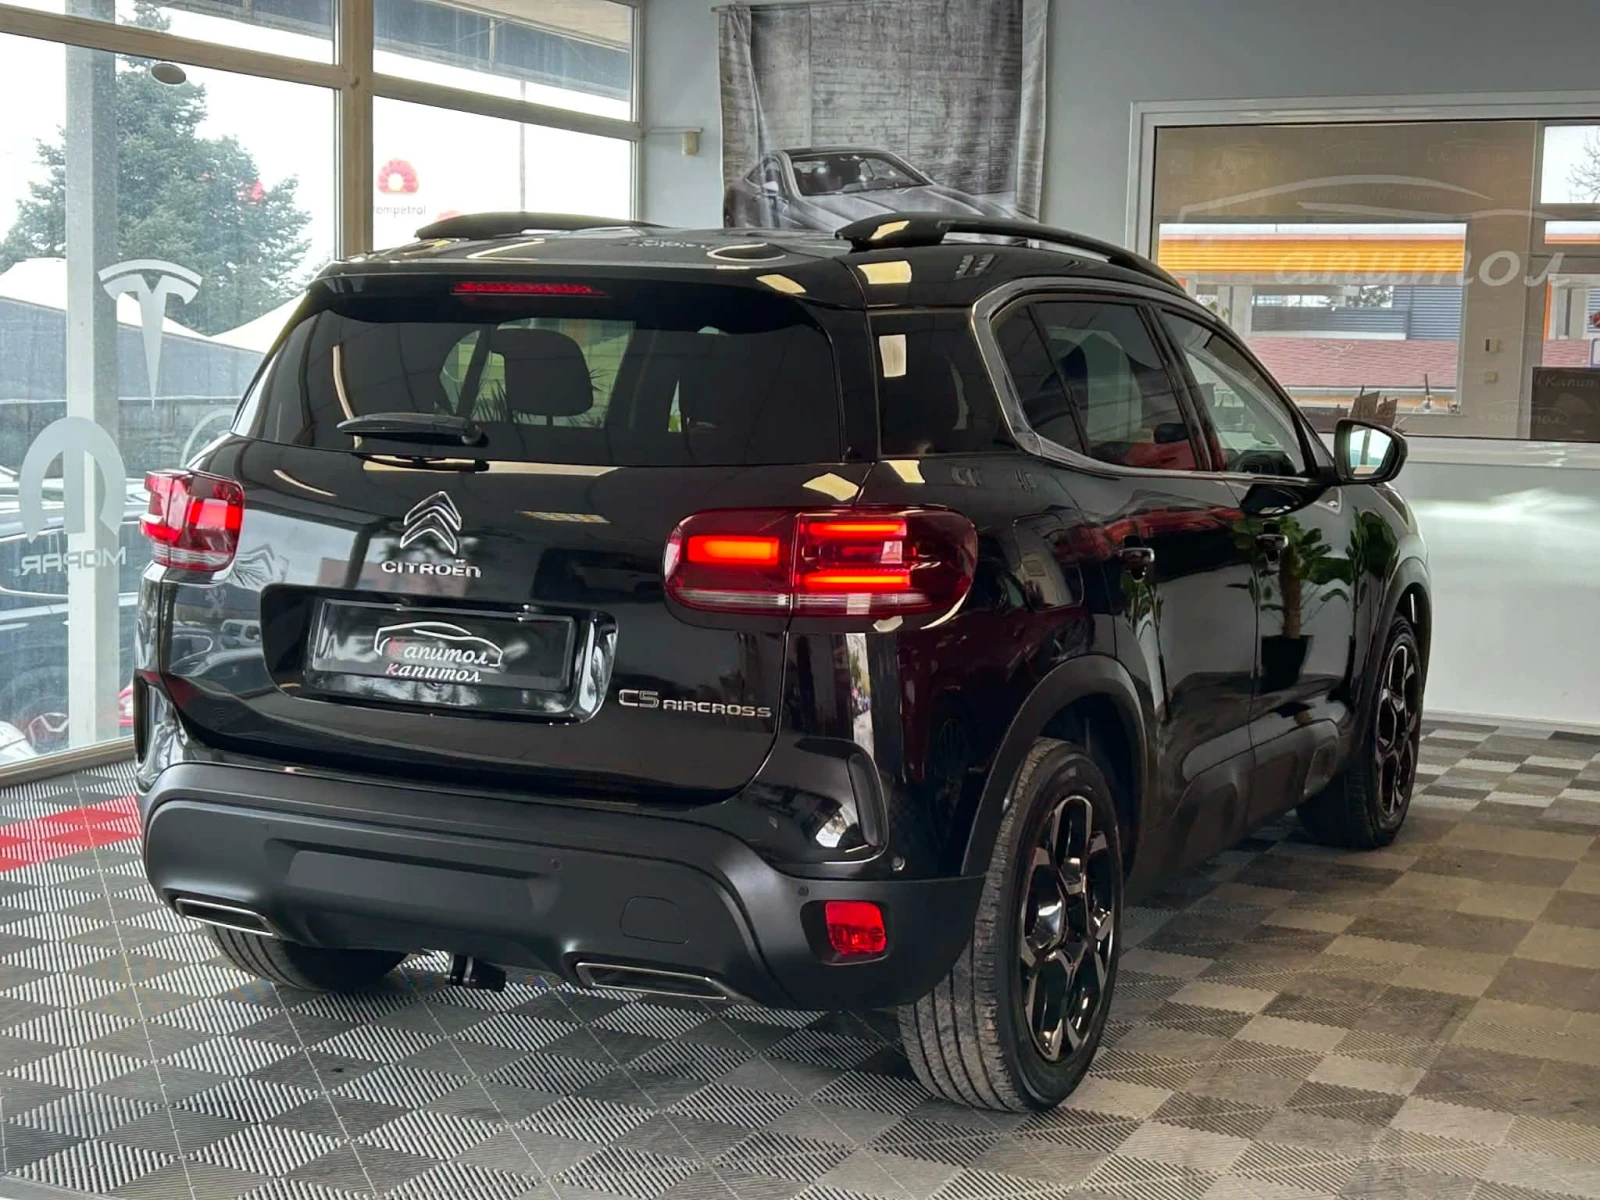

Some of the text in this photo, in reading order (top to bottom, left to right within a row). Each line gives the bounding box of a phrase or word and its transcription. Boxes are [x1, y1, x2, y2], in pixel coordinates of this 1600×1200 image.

[372, 204, 426, 218] ompetrol
[618, 688, 772, 718] C5 AIRCROSS
